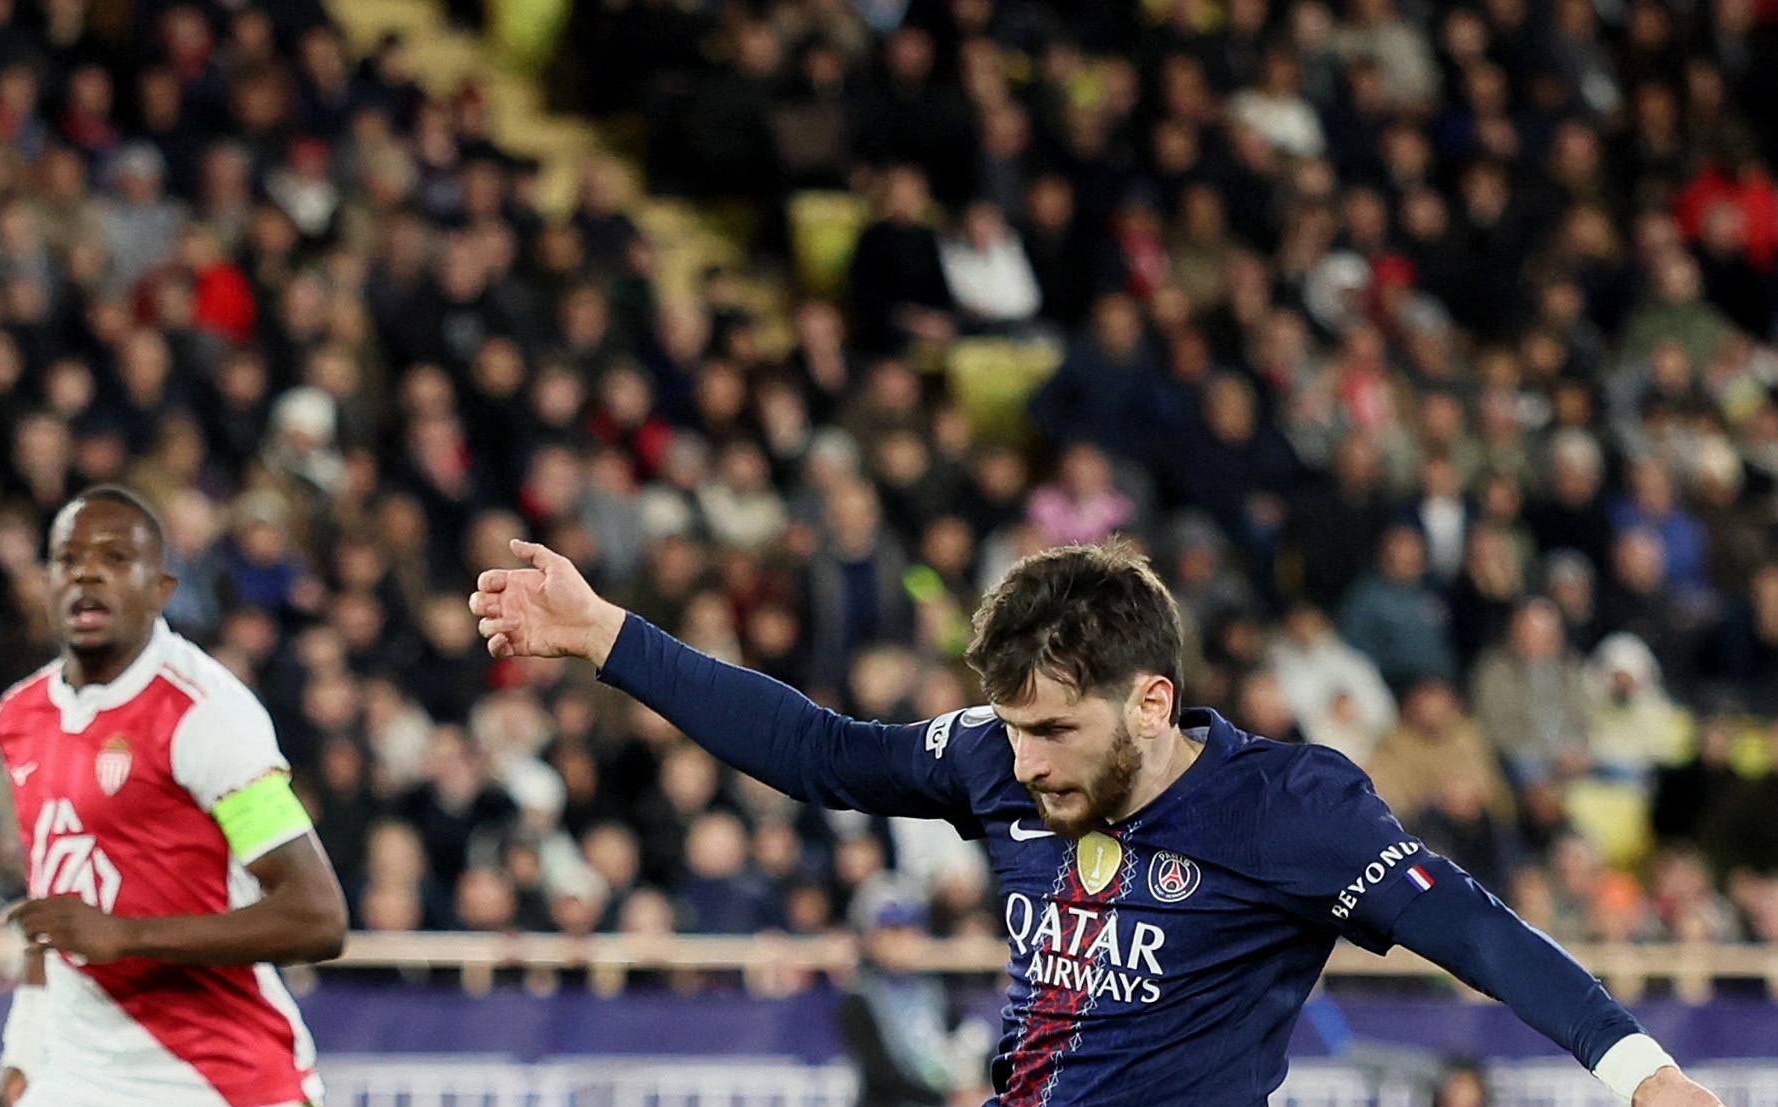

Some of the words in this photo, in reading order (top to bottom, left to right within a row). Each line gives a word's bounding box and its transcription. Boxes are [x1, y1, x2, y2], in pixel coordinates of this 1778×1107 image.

[1331, 841, 1420, 921] BEYOND
[1006, 892, 1166, 976] QATAR
[1024, 950, 1162, 1005] AIRWAYS
